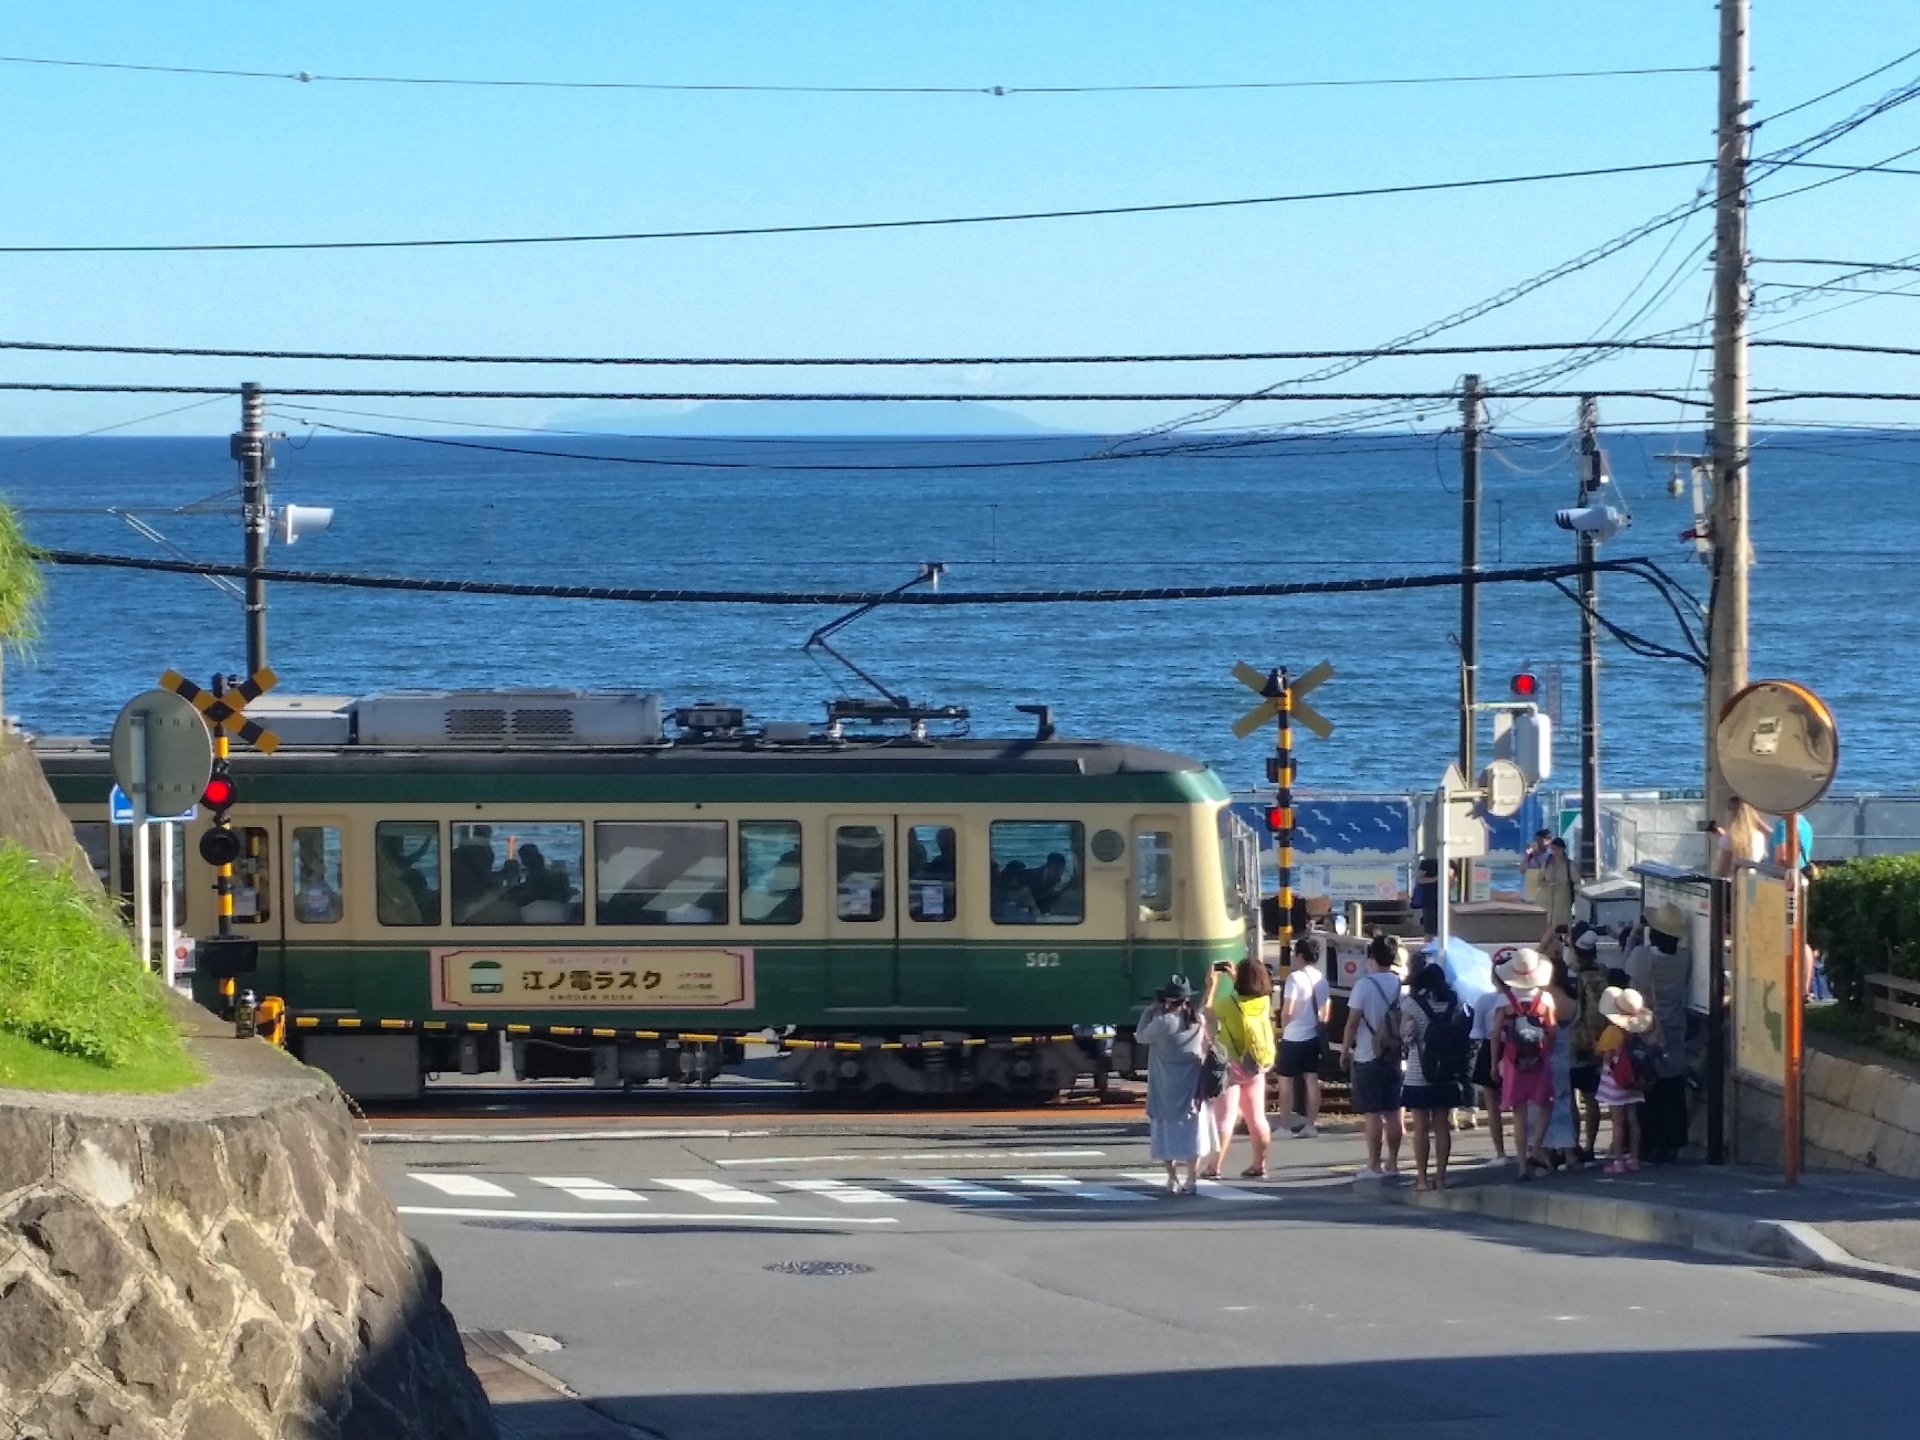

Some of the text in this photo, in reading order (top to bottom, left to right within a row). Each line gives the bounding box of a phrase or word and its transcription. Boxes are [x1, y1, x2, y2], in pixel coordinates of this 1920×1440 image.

[522, 970, 662, 991] 江ノ電ラスク
